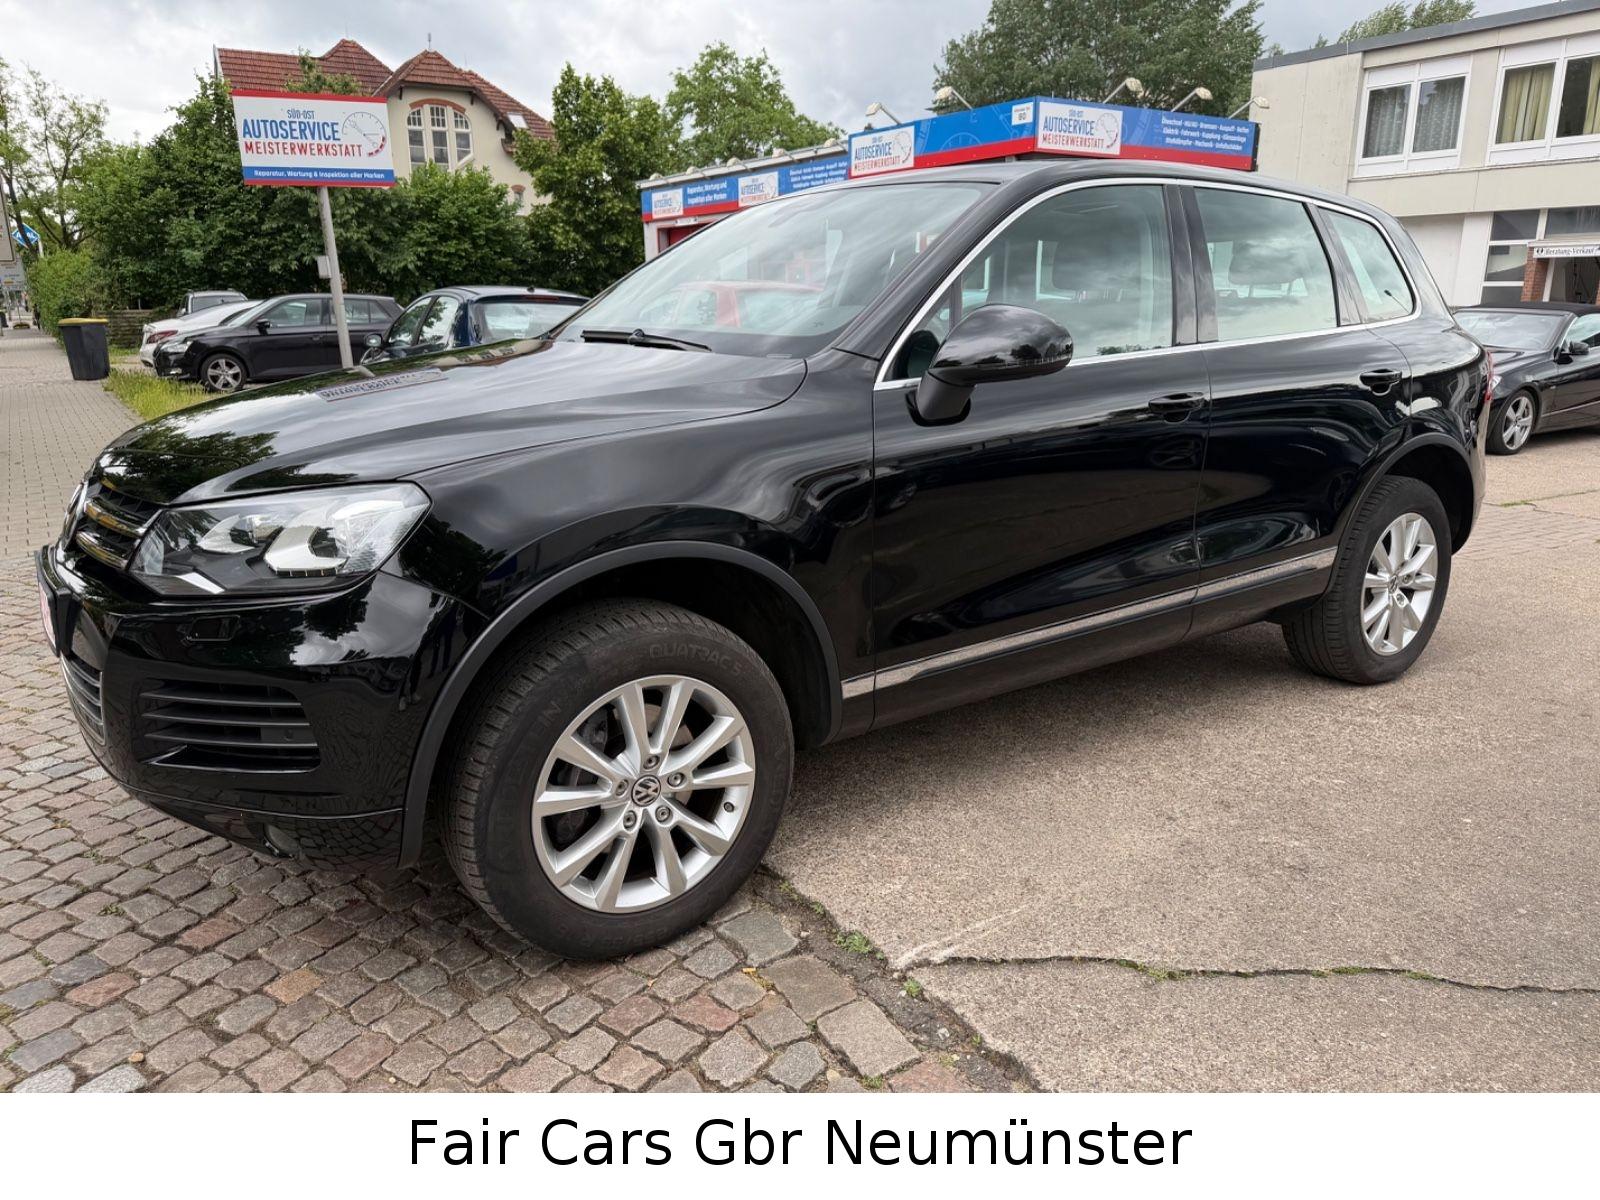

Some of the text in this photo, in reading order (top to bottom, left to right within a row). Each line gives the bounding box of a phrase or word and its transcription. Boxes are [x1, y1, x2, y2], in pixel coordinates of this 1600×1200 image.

[287, 109, 315, 119] SÜD-OST
[242, 119, 341, 141] AUTOSERVICE
[1043, 116, 1095, 136] AUTOSERVICE
[244, 141, 363, 157] MEISTERWERKSTATT
[1042, 133, 1105, 149] MEISTERWERKSTATT
[855, 142, 892, 161] AUTOSERVICE
[287, 170, 312, 179] Wartung
[319, 171, 349, 179] Inspektion
